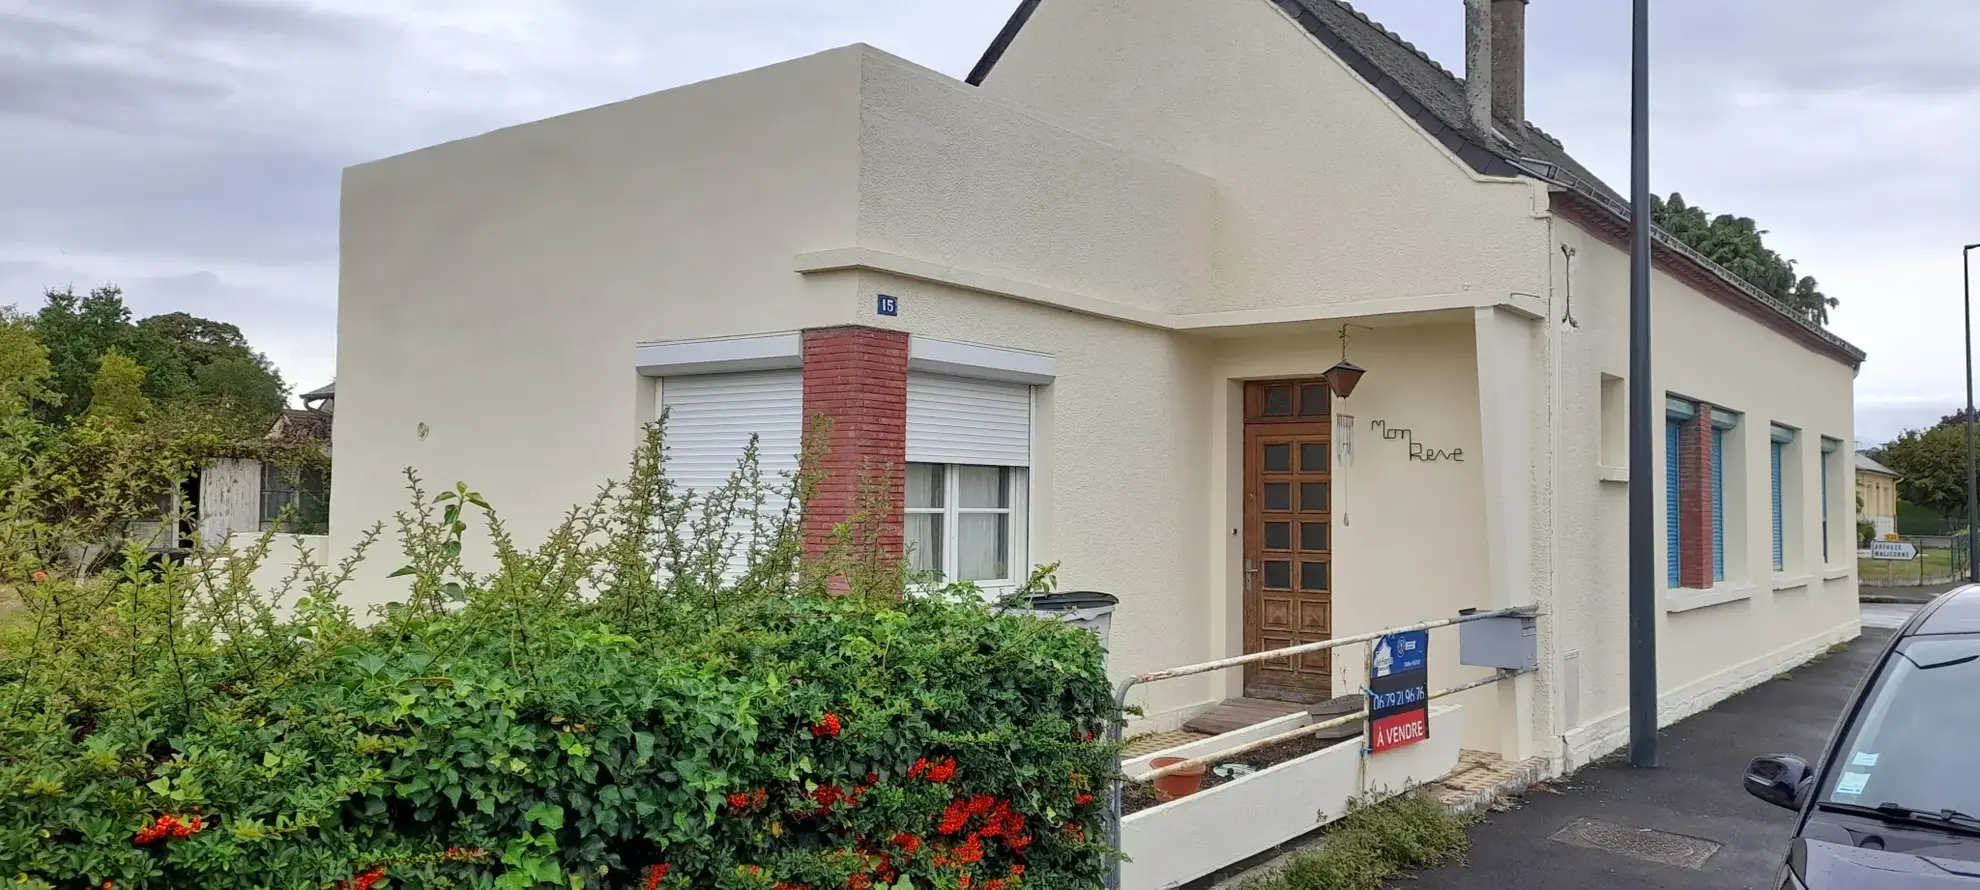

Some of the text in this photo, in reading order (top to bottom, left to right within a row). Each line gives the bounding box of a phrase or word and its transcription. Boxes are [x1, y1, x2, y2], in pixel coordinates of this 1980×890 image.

[882, 298, 894, 312] 15
[1371, 419, 1411, 440] Mon
[1373, 685, 1425, 710] 06 79 21 96 76
[1376, 720, 1424, 748] À VENDRE
